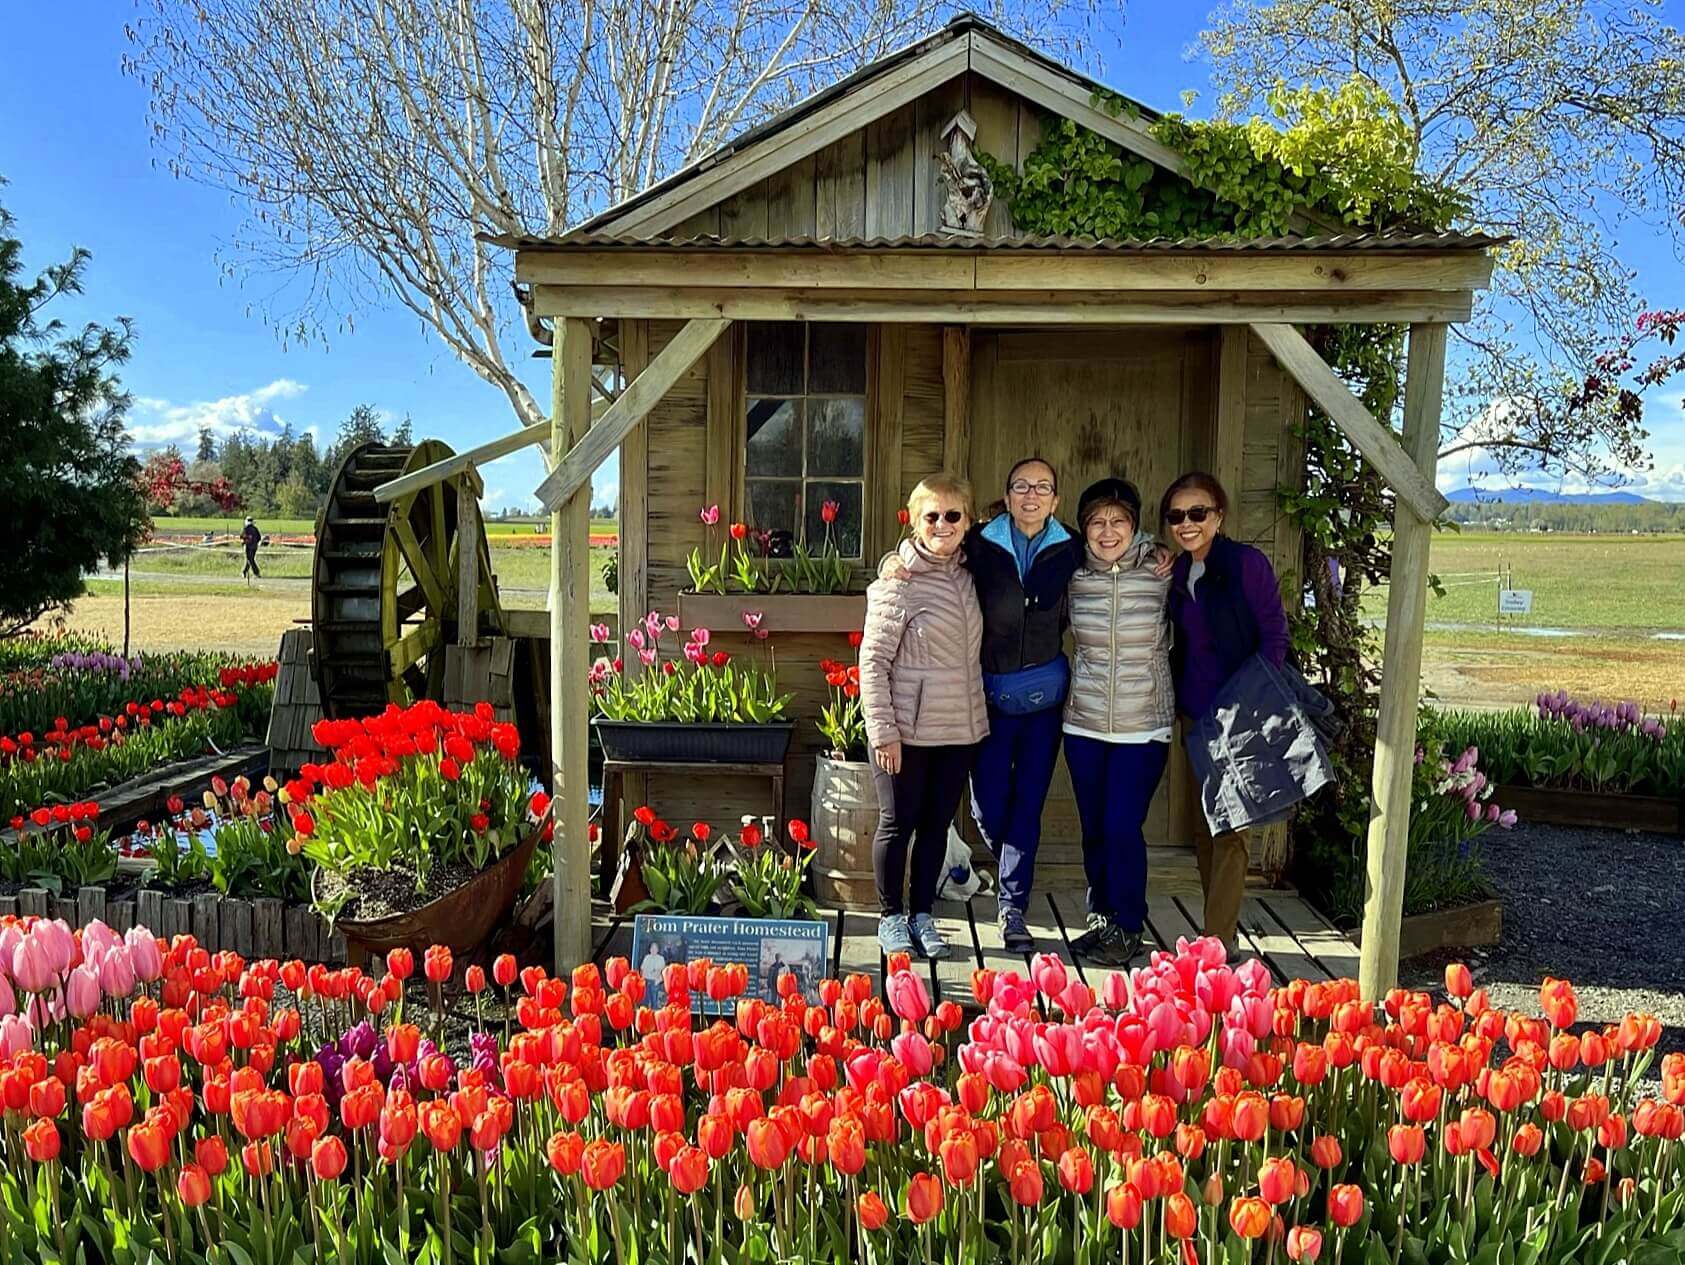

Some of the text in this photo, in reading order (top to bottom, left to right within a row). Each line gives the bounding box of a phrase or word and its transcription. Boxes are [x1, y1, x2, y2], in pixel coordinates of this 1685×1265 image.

[643, 918, 821, 938] Tom Prater Homestead
